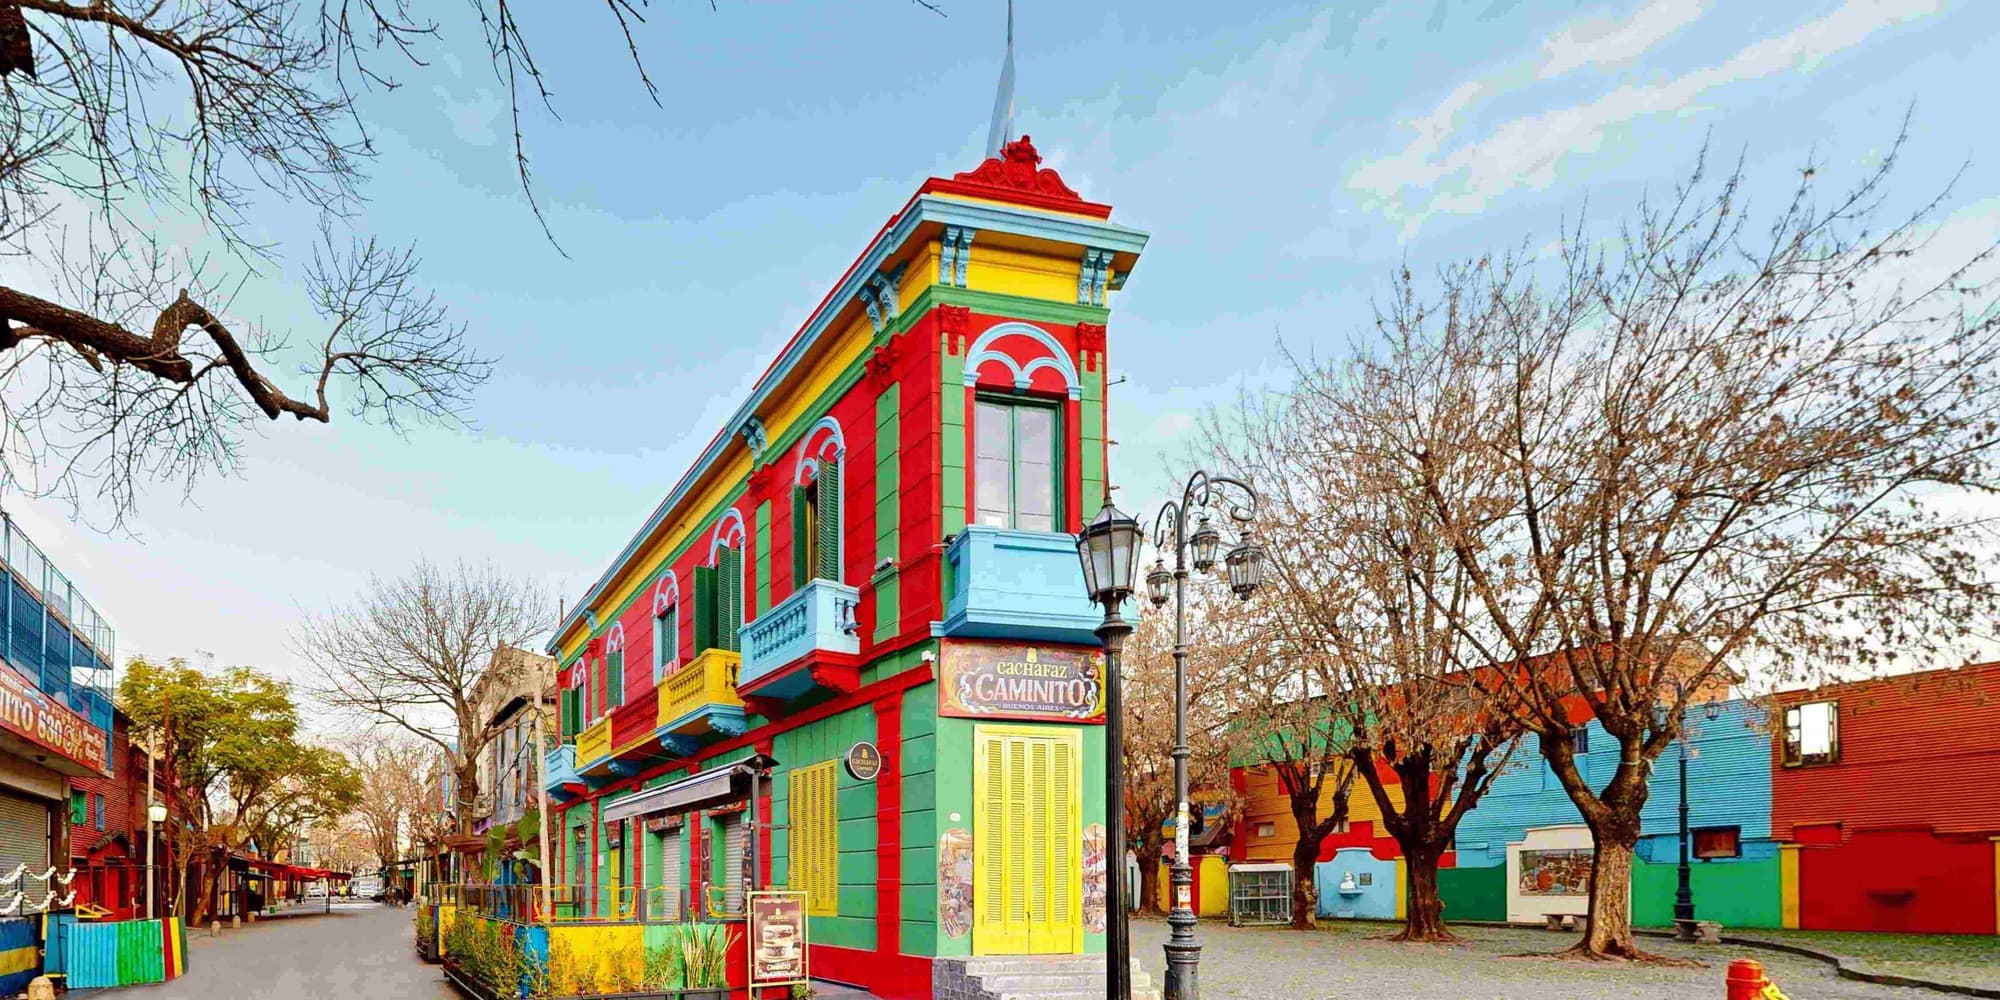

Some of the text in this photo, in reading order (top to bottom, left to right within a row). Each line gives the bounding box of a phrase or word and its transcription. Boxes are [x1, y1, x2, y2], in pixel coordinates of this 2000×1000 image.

[975, 673, 1086, 707] CAMINITO
[1003, 703, 1060, 712] BUENOS AIRES
[37, 709, 62, 747] 630
